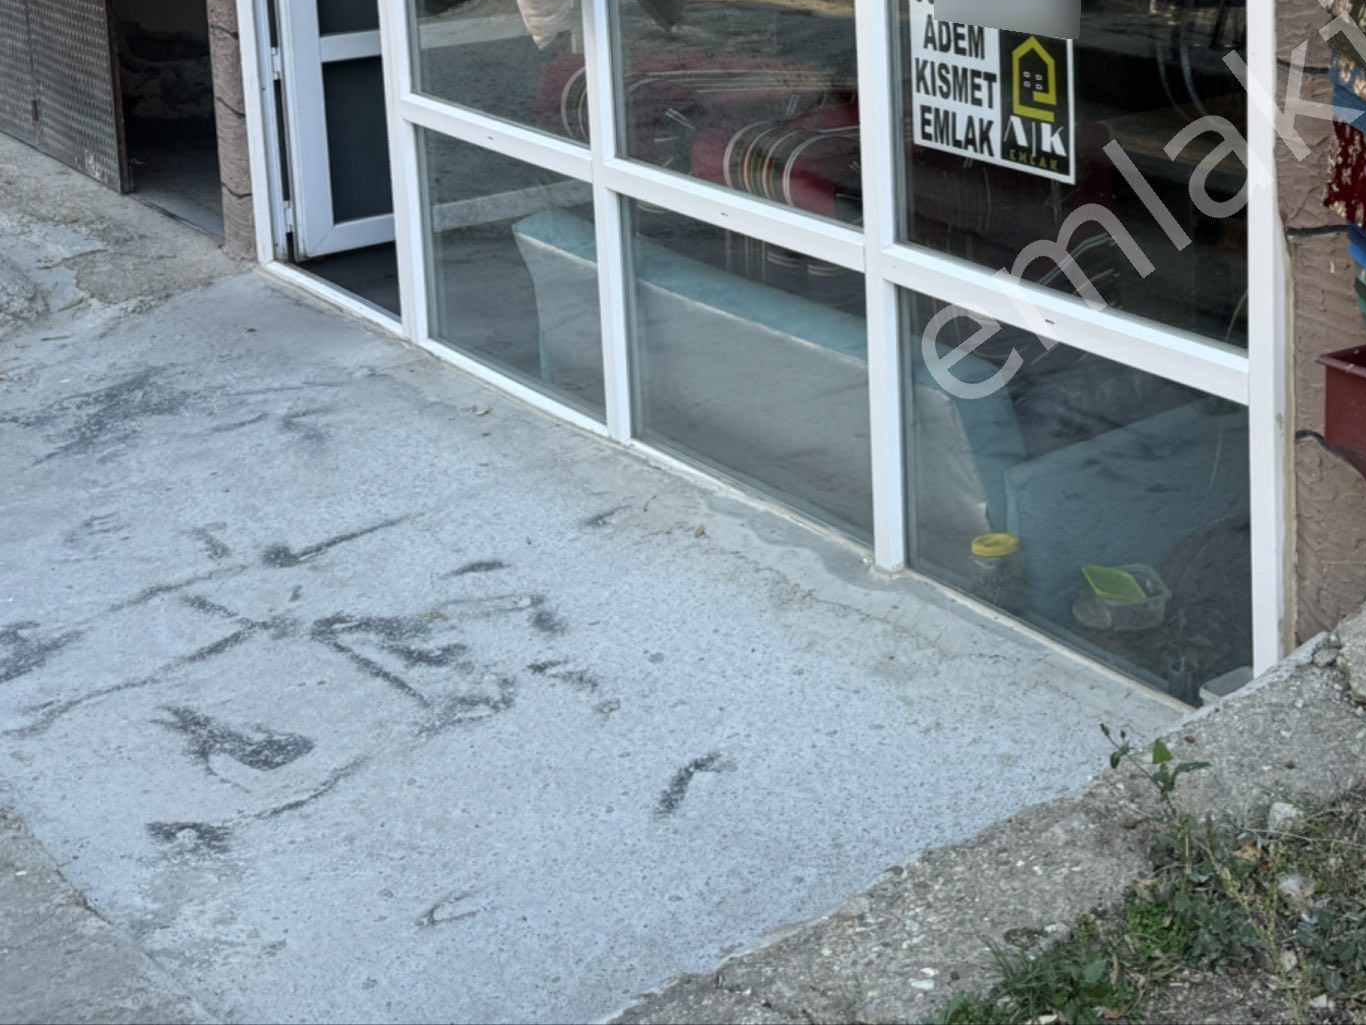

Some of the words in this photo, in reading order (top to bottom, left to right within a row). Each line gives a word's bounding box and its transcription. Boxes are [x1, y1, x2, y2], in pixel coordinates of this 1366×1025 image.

[923, 14, 985, 60] ADEM
[915, 57, 997, 110] KISMET
[919, 104, 994, 158] EMLAK
